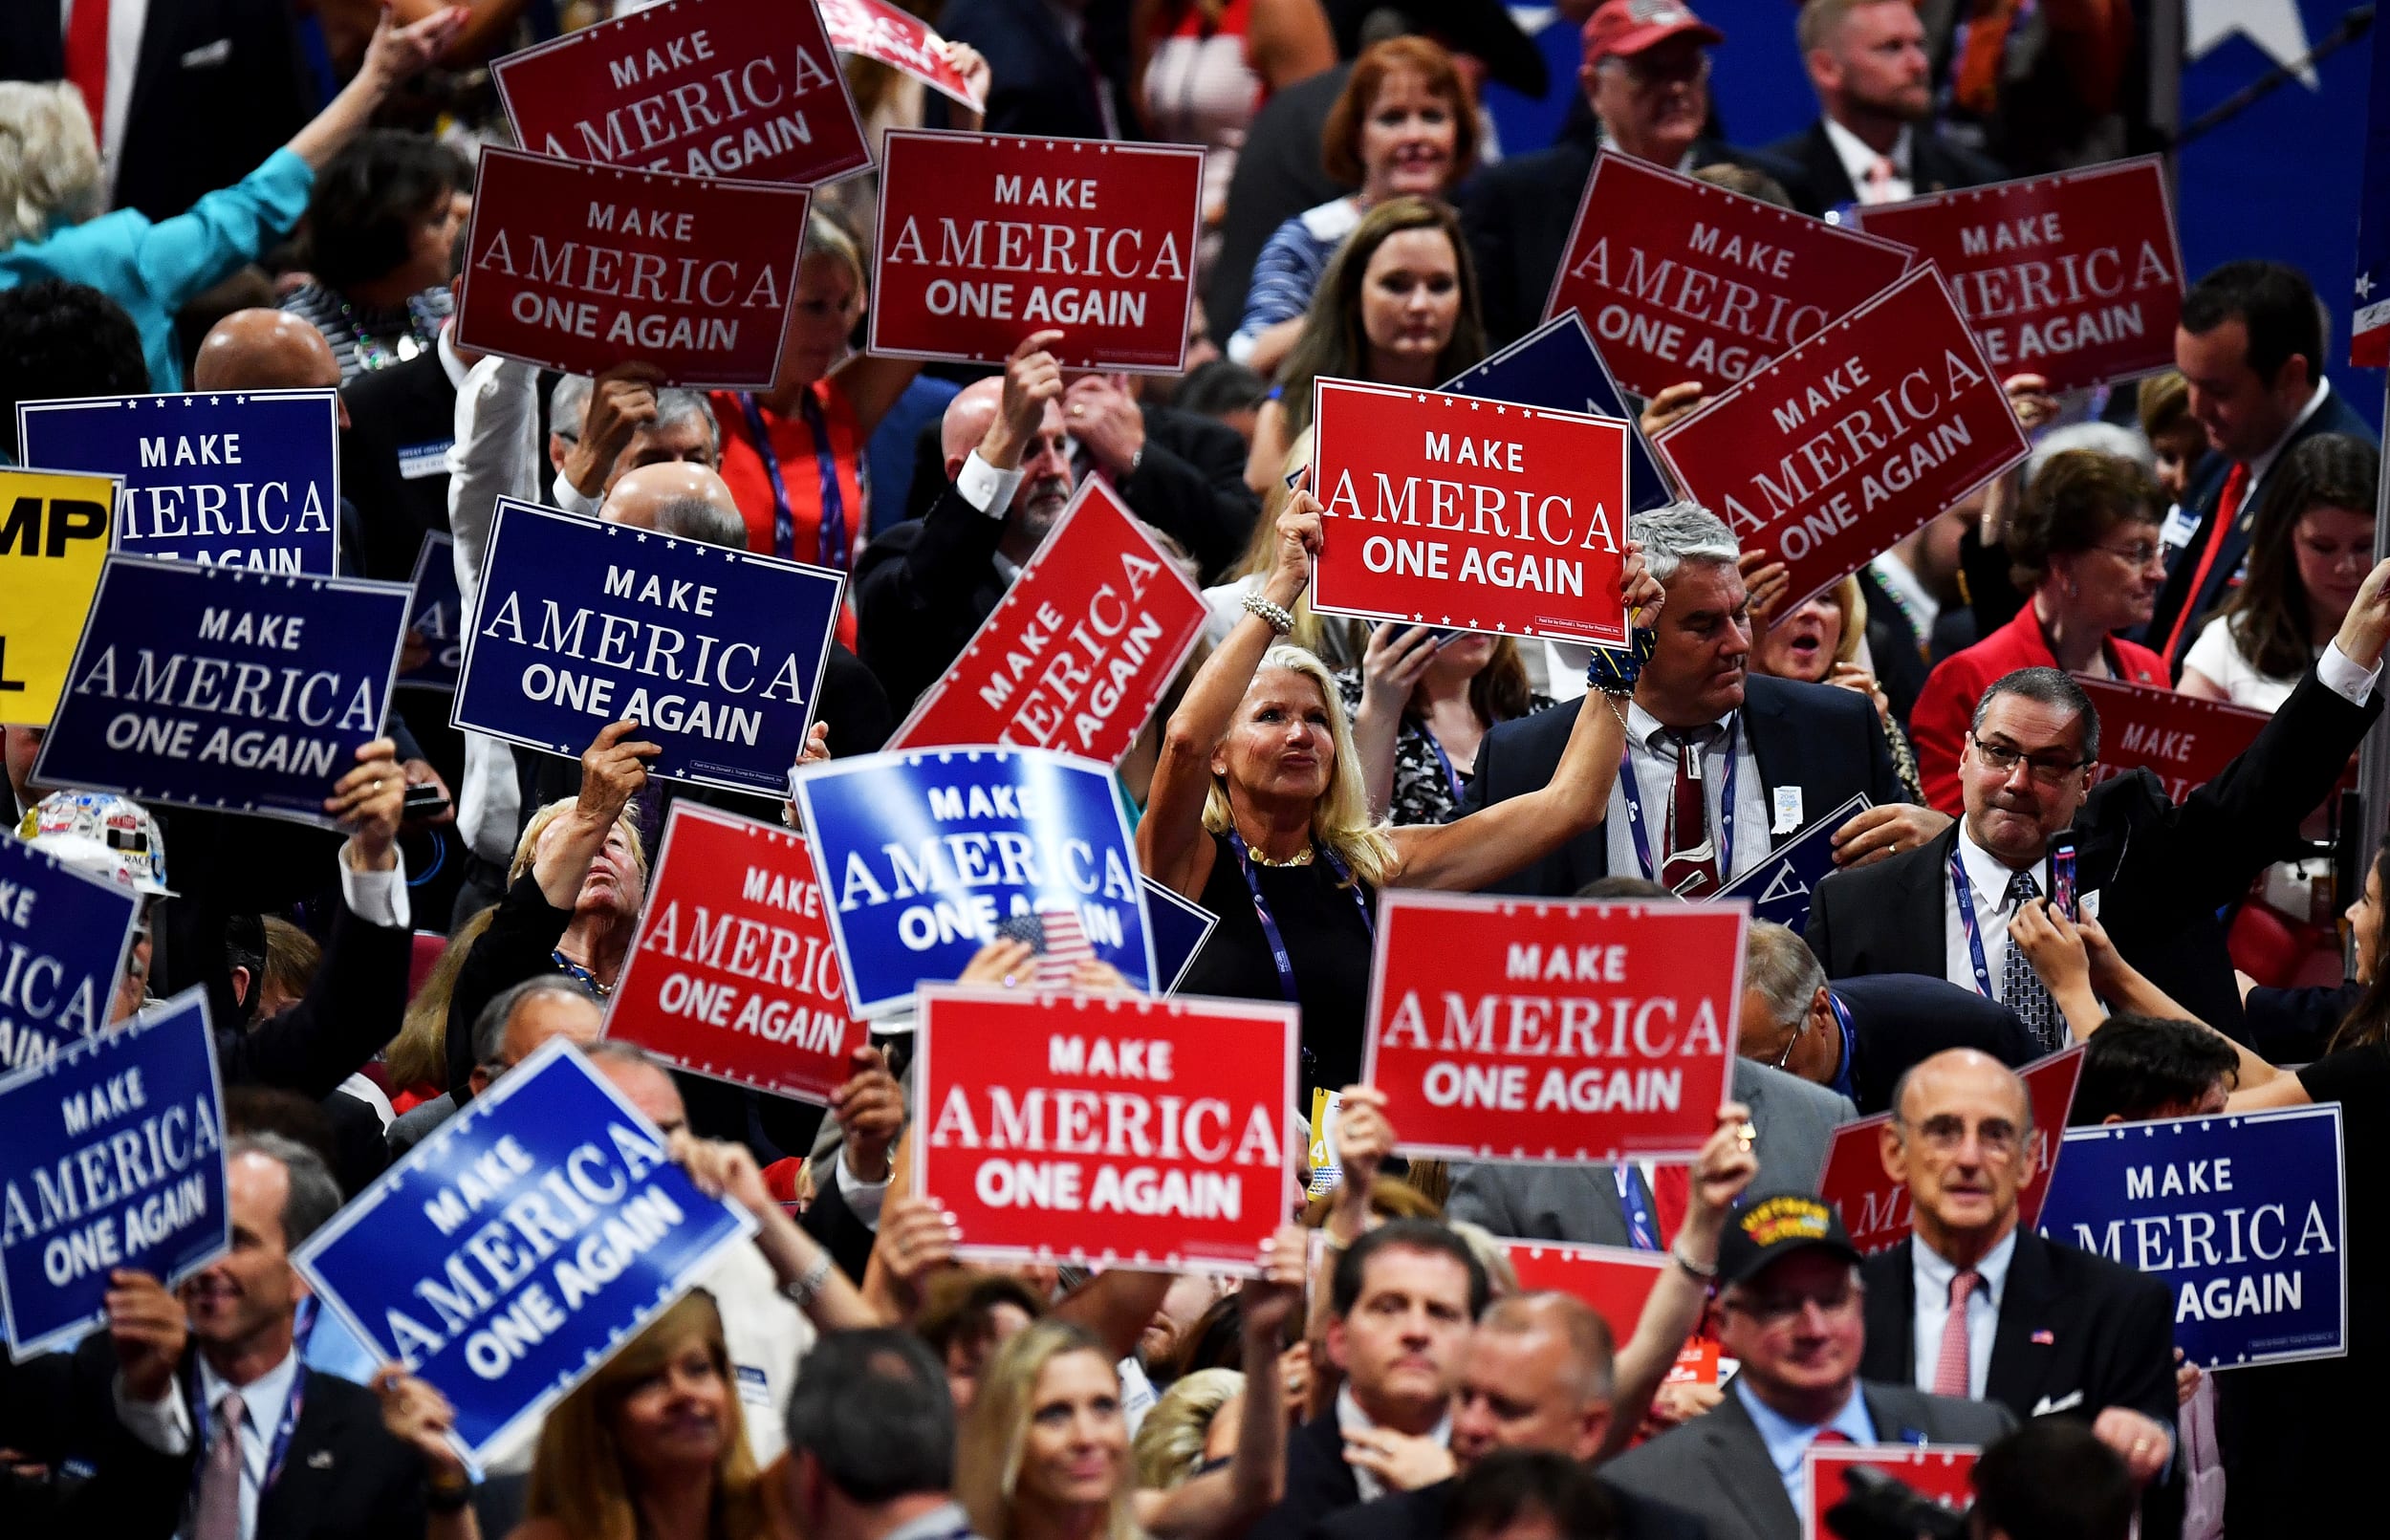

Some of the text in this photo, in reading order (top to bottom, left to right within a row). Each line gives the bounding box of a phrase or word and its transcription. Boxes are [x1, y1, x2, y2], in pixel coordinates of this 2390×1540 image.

[609, 30, 715, 90] MAKE
[687, 110, 813, 179] AGAIN
[587, 202, 694, 241] MAKE
[994, 174, 1097, 209] MAKE
[886, 215, 1185, 281] AMERICA
[1688, 222, 1795, 279] MAKE
[1960, 211, 2065, 257] MAKE
[475, 228, 781, 310] AMERICA
[1570, 237, 1830, 349] AMERIC
[1949, 239, 2173, 321] ERICA
[511, 291, 739, 352] ONE AGAIN
[925, 279, 1146, 328] ONE AGAIN
[1597, 304, 1685, 361] ONE
[2018, 301, 2145, 359] AGAIN
[1771, 356, 1871, 434] MAKE
[140, 433, 242, 467] MAKE
[1424, 431, 1524, 473] MAKE
[1724, 349, 1985, 542] AMERICA
[122, 480, 331, 540] ERICA
[1323, 468, 1619, 553] AMERICA
[1779, 413, 1973, 561] ONE AGAIN
[603, 565, 717, 618] MAKE
[1362, 536, 1583, 596] ONE AGAIN
[198, 606, 305, 651] MAKE
[482, 590, 805, 705] AMERICA
[979, 600, 1064, 711] MAKE
[997, 552, 1162, 751] ERICA
[75, 643, 376, 732] AMERICA
[521, 662, 762, 746] ONE AGAIN
[1074, 610, 1163, 750] AGAIN
[105, 712, 339, 779] ONE AGAIN
[2120, 722, 2196, 763] MAKE
[927, 784, 1037, 821] MAKE
[742, 865, 819, 919] MAKE
[837, 831, 1137, 912] AMERCA
[641, 900, 843, 1001] AMERIC
[898, 894, 997, 951] ONE
[1507, 943, 1627, 983] MAKE
[659, 972, 845, 1056] ONE AGAIN
[1381, 991, 1726, 1057] AMERICA
[1049, 1033, 1174, 1080] MAKE
[1423, 1062, 1682, 1113] ONE AGAIN
[60, 1065, 147, 1137] MAKE
[929, 1083, 1282, 1167] AMERICA
[2, 1094, 219, 1243] AMERICA
[424, 1133, 535, 1235] MAKE
[975, 1158, 1240, 1221] ONE AGAIN
[2125, 1157, 2233, 1200] MAKE
[43, 1228, 121, 1288] ONE
[125, 1173, 206, 1256] AGAIN
[385, 1121, 665, 1372] AMERICA
[2039, 1199, 2336, 1272] MERICA
[465, 1183, 684, 1380] ONE AGAIN
[2175, 1270, 2302, 1323] AGAIN
